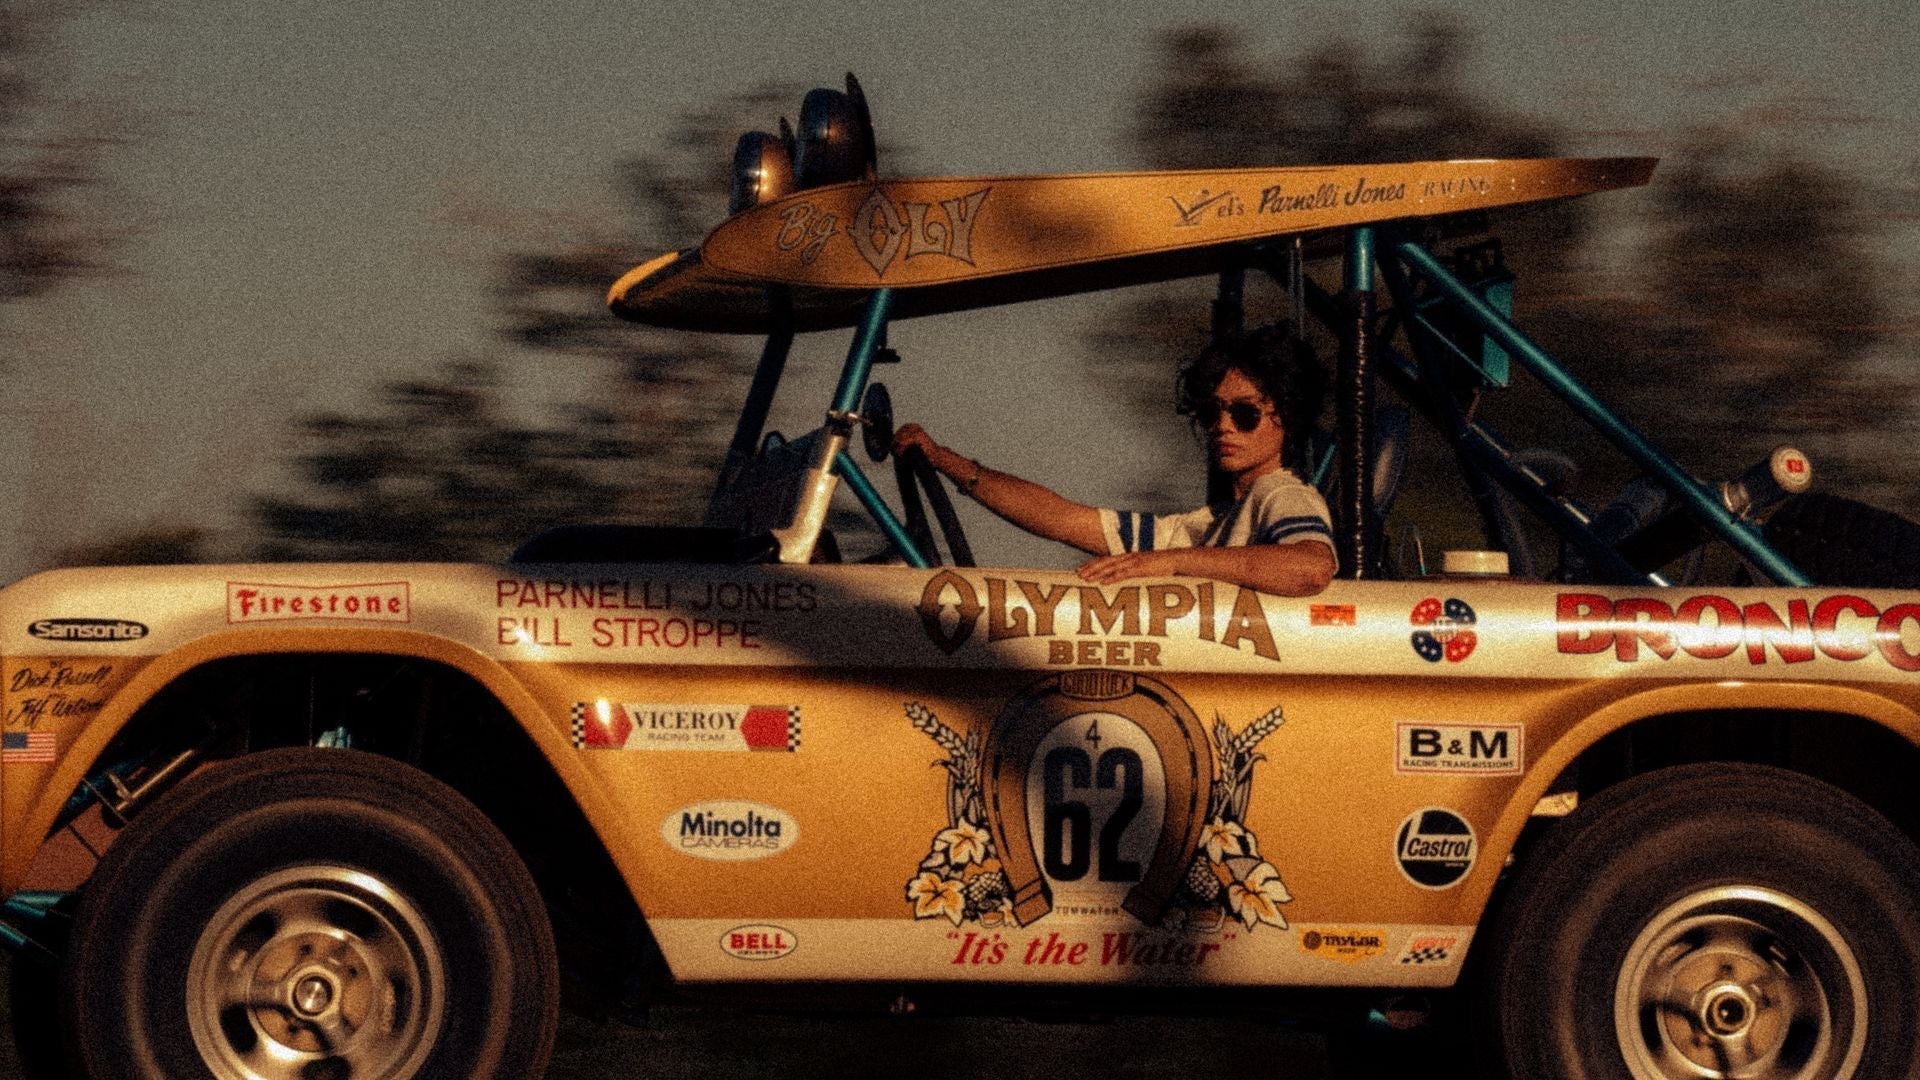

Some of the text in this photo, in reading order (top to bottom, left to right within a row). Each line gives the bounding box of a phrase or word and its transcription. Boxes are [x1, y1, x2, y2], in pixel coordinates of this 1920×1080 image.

[1259, 183, 1340, 214] Parnelli
[1344, 177, 1406, 206] Jones
[777, 187, 994, 279] Big OLY
[236, 588, 401, 617] Firestone
[496, 579, 818, 612] PARNELLI JONES
[914, 569, 1281, 662] OLYMPIA
[34, 621, 142, 640] Samsonite
[591, 617, 761, 649] STROPPE
[1047, 639, 1163, 667] BEER
[632, 710, 741, 731] VICEROY
[1085, 719, 1102, 749] 4
[647, 732, 726, 743] RACING TEAM
[1403, 759, 1438, 767] RACING
[680, 811, 781, 837] Minolta
[1043, 746, 1144, 882] 62
[680, 837, 779, 849] CAMERAS
[1407, 838, 1473, 858] Castrol
[730, 933, 788, 949] BELL
[1023, 932, 1089, 965] the
[1322, 936, 1380, 947] TAYLOR
